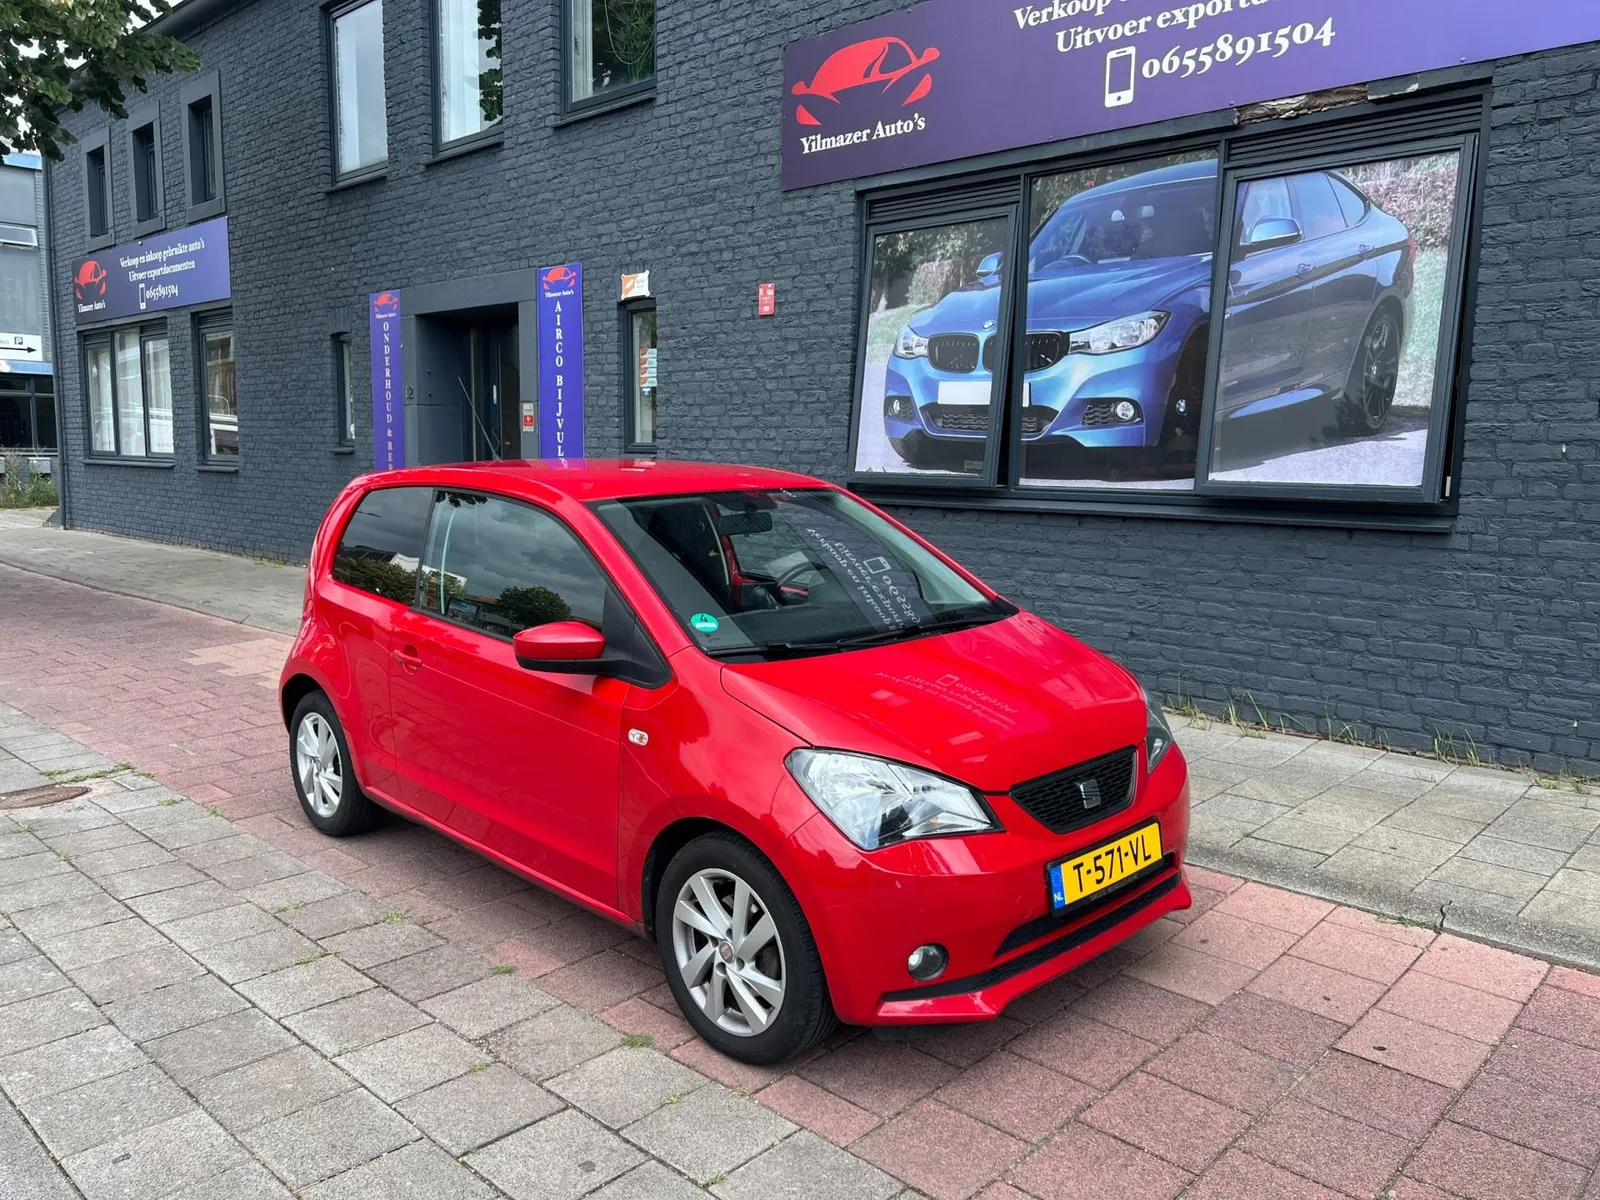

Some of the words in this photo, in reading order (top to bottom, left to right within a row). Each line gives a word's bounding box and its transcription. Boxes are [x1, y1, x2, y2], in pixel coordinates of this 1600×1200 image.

[1013, 0, 1112, 29] Verkoop
[1056, 15, 1152, 52] Uitvoer
[1156, 0, 1268, 29] expor
[1142, 17, 1336, 78] 0655891504
[800, 128, 871, 154] Yilmazer
[872, 112, 926, 139] Auto's
[120, 256, 139, 268] Verkoop
[146, 250, 162, 262] inkoop
[163, 243, 188, 261] gebruikte
[129, 271, 147, 282] Uitvoer
[555, 301, 564, 367] AIRCO
[383, 321, 393, 423] ONDERHOUD
[700, 613, 708, 623] 4
[1073, 835, 1151, 892] T-571-VL
[1053, 892, 1064, 903] NL
